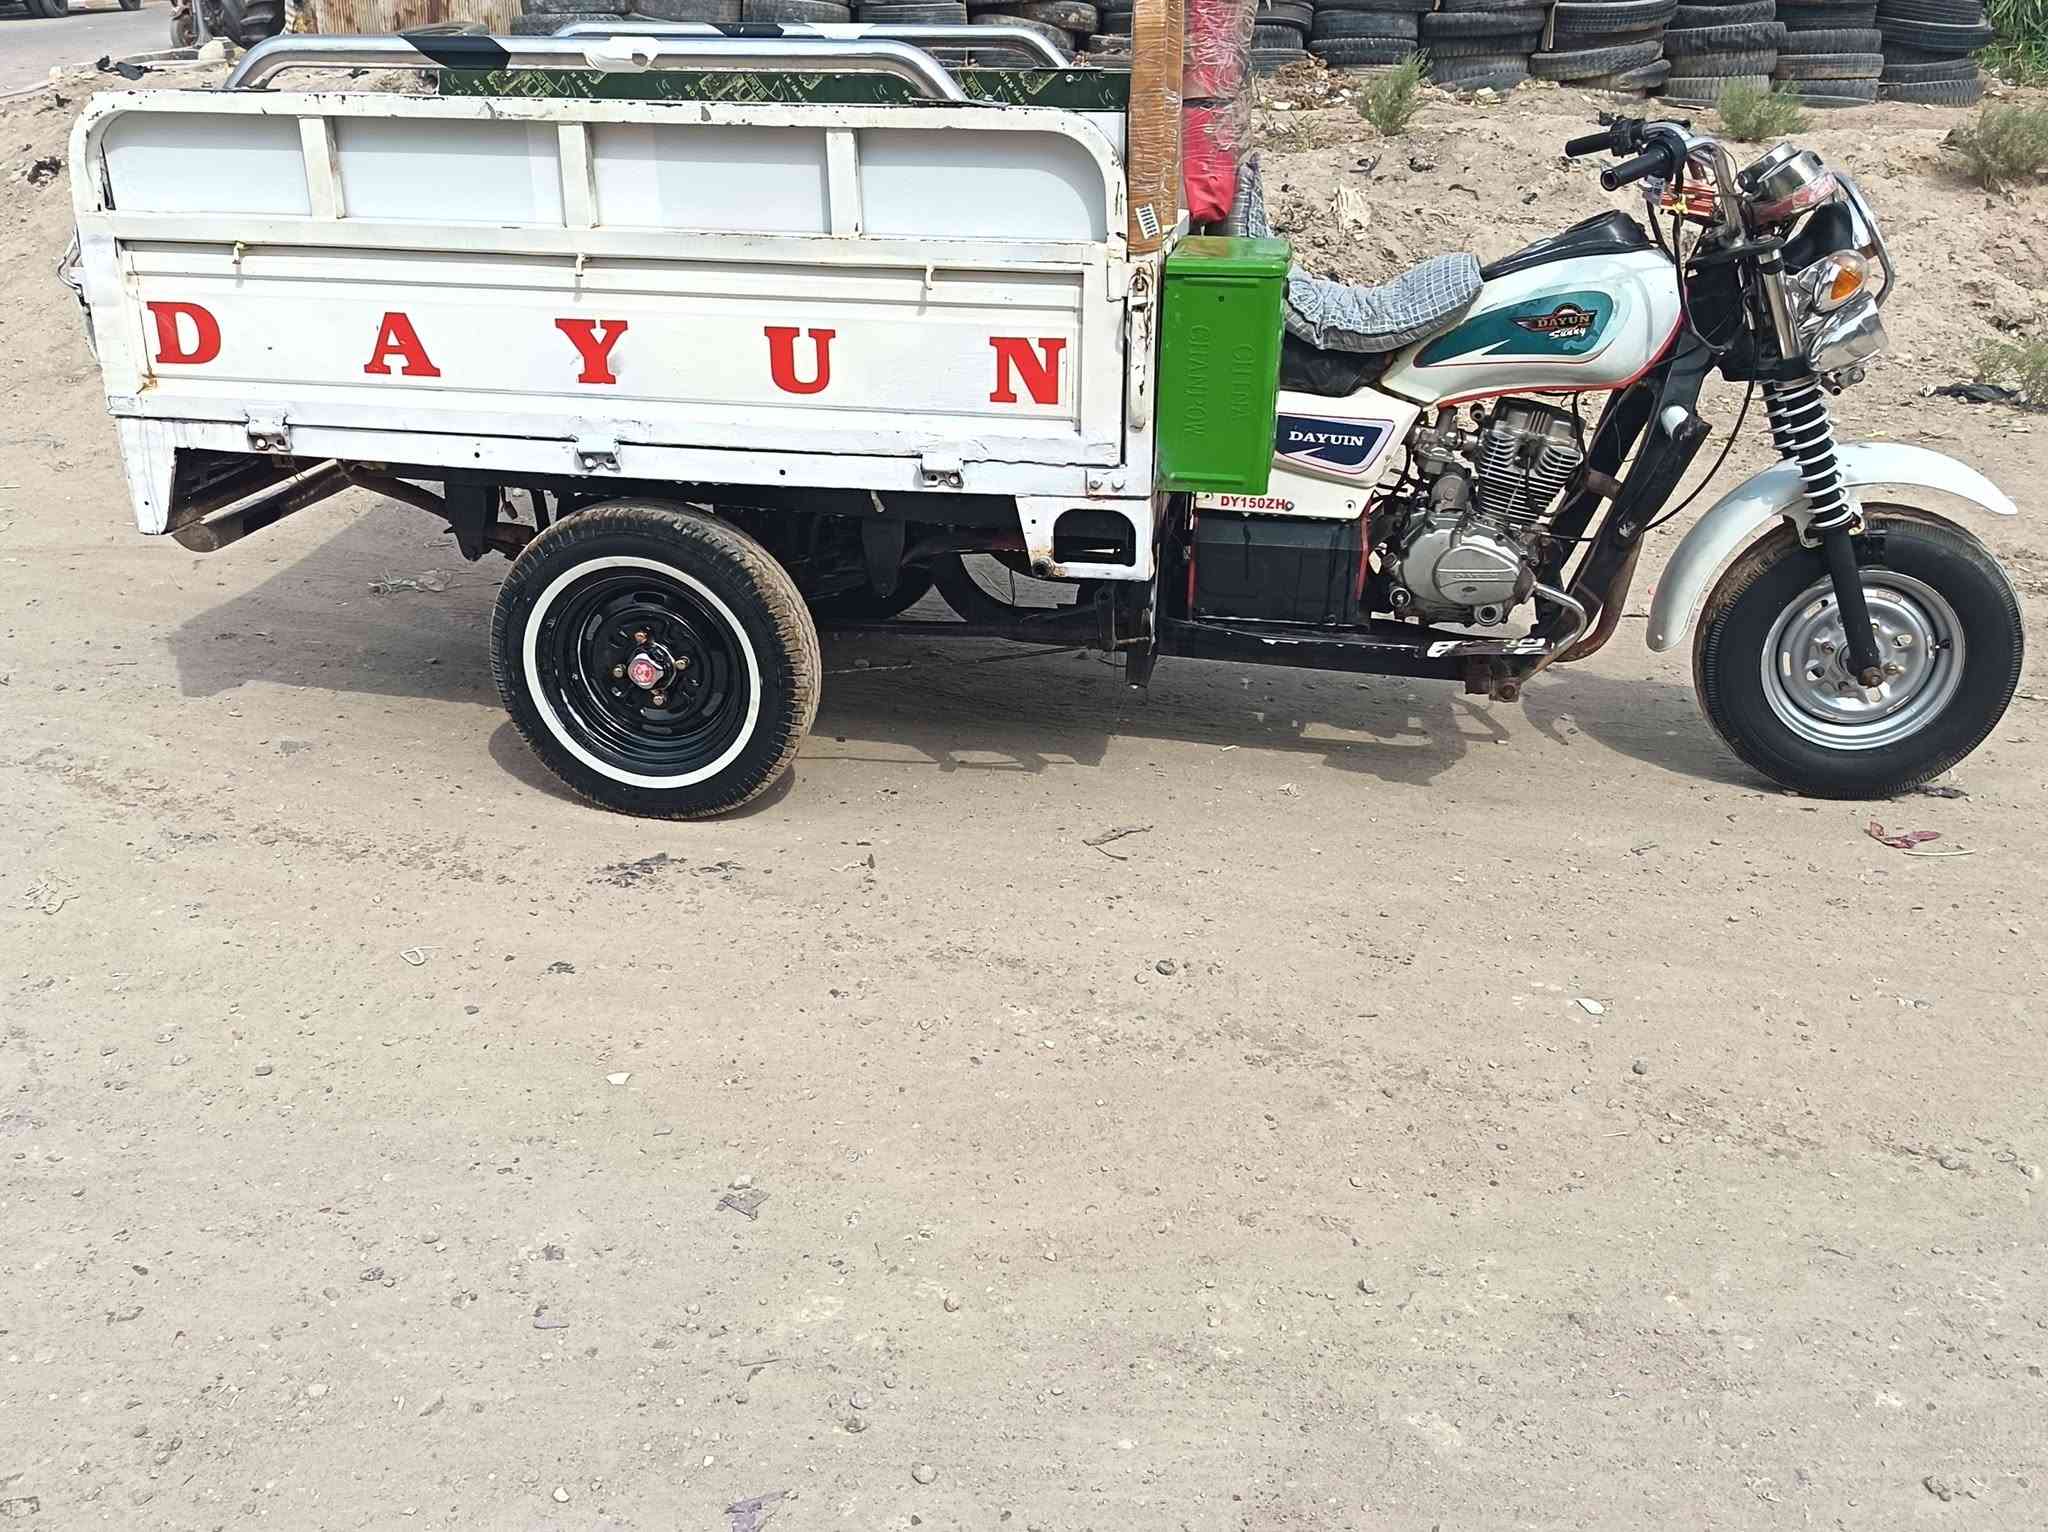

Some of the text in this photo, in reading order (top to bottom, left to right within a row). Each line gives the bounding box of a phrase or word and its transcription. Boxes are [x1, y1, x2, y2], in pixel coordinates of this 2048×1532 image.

[1537, 315, 1590, 328] DAYUN
[148, 303, 1066, 404] DAYUN
[1288, 430, 1365, 446] DAYUIN
